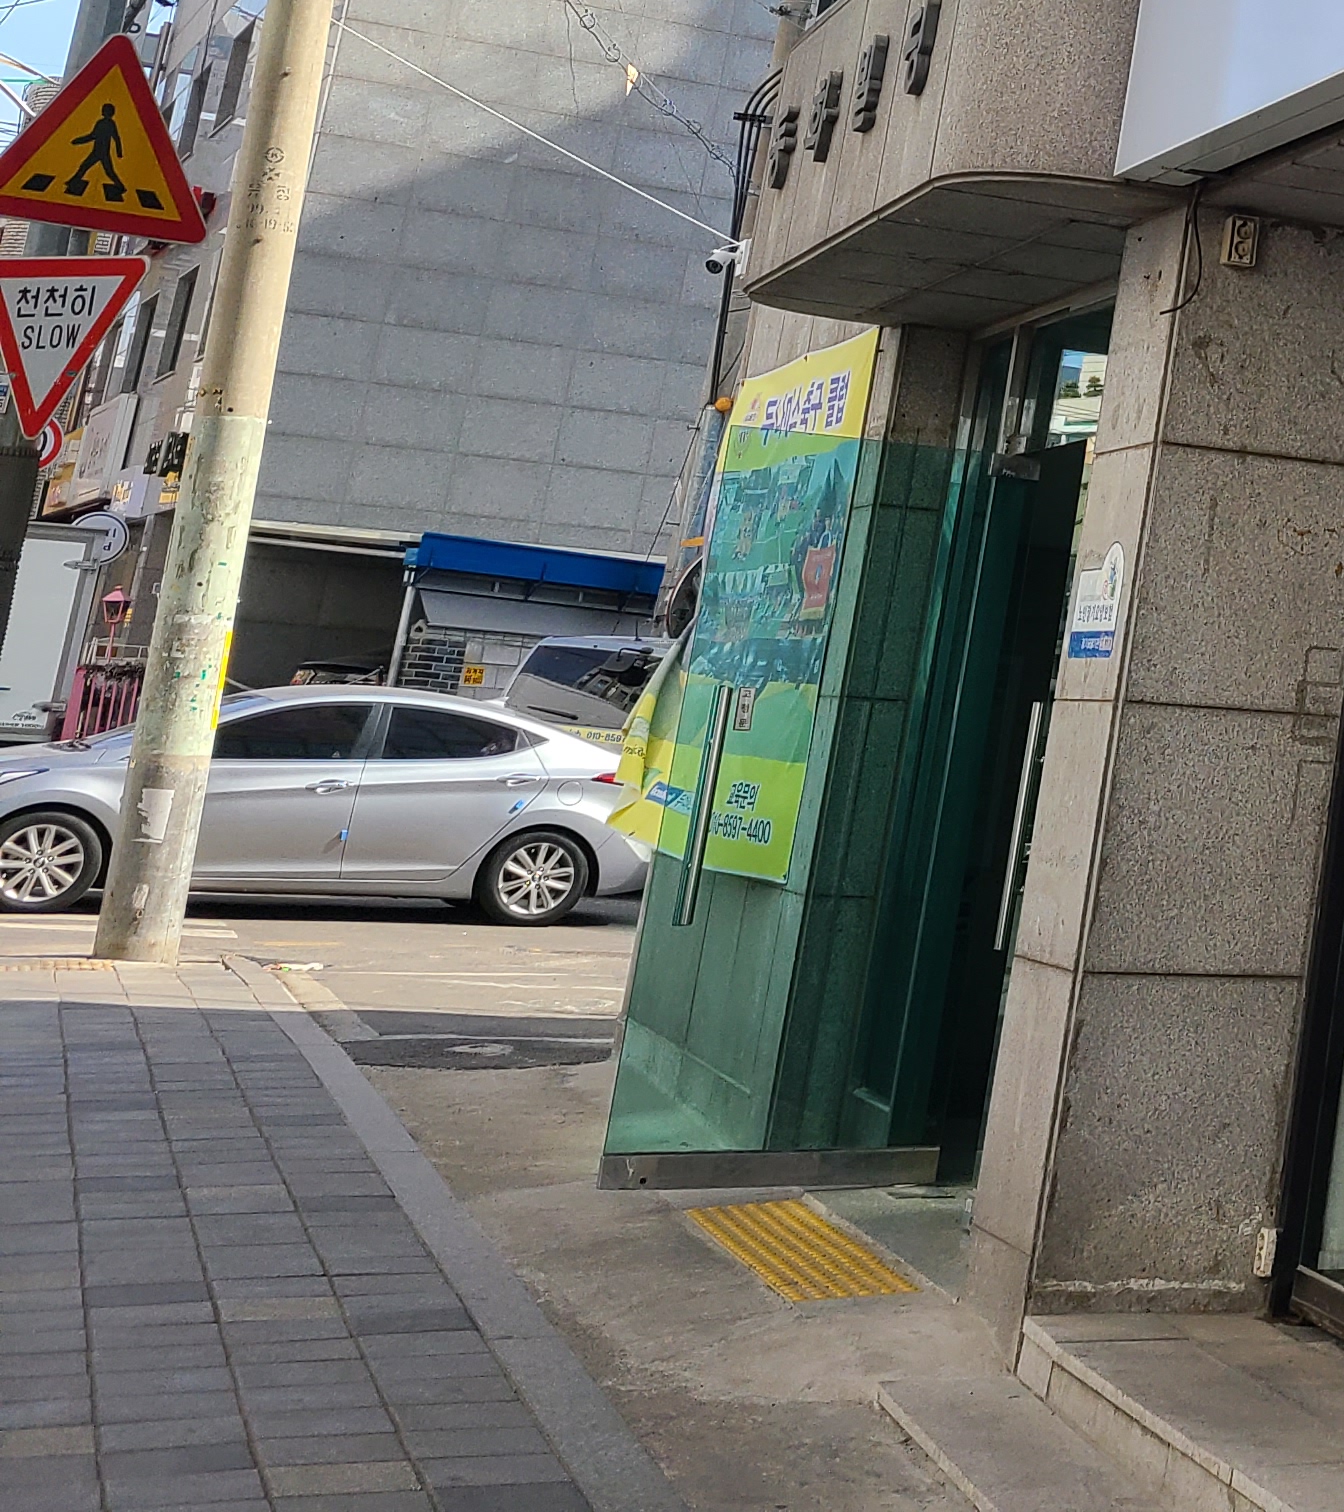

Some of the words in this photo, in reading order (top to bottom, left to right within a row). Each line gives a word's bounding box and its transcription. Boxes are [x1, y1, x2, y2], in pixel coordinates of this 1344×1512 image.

[16, 284, 97, 318] 천천히
[21, 323, 81, 349] SLOW
[726, 782, 760, 811] 교육문의
